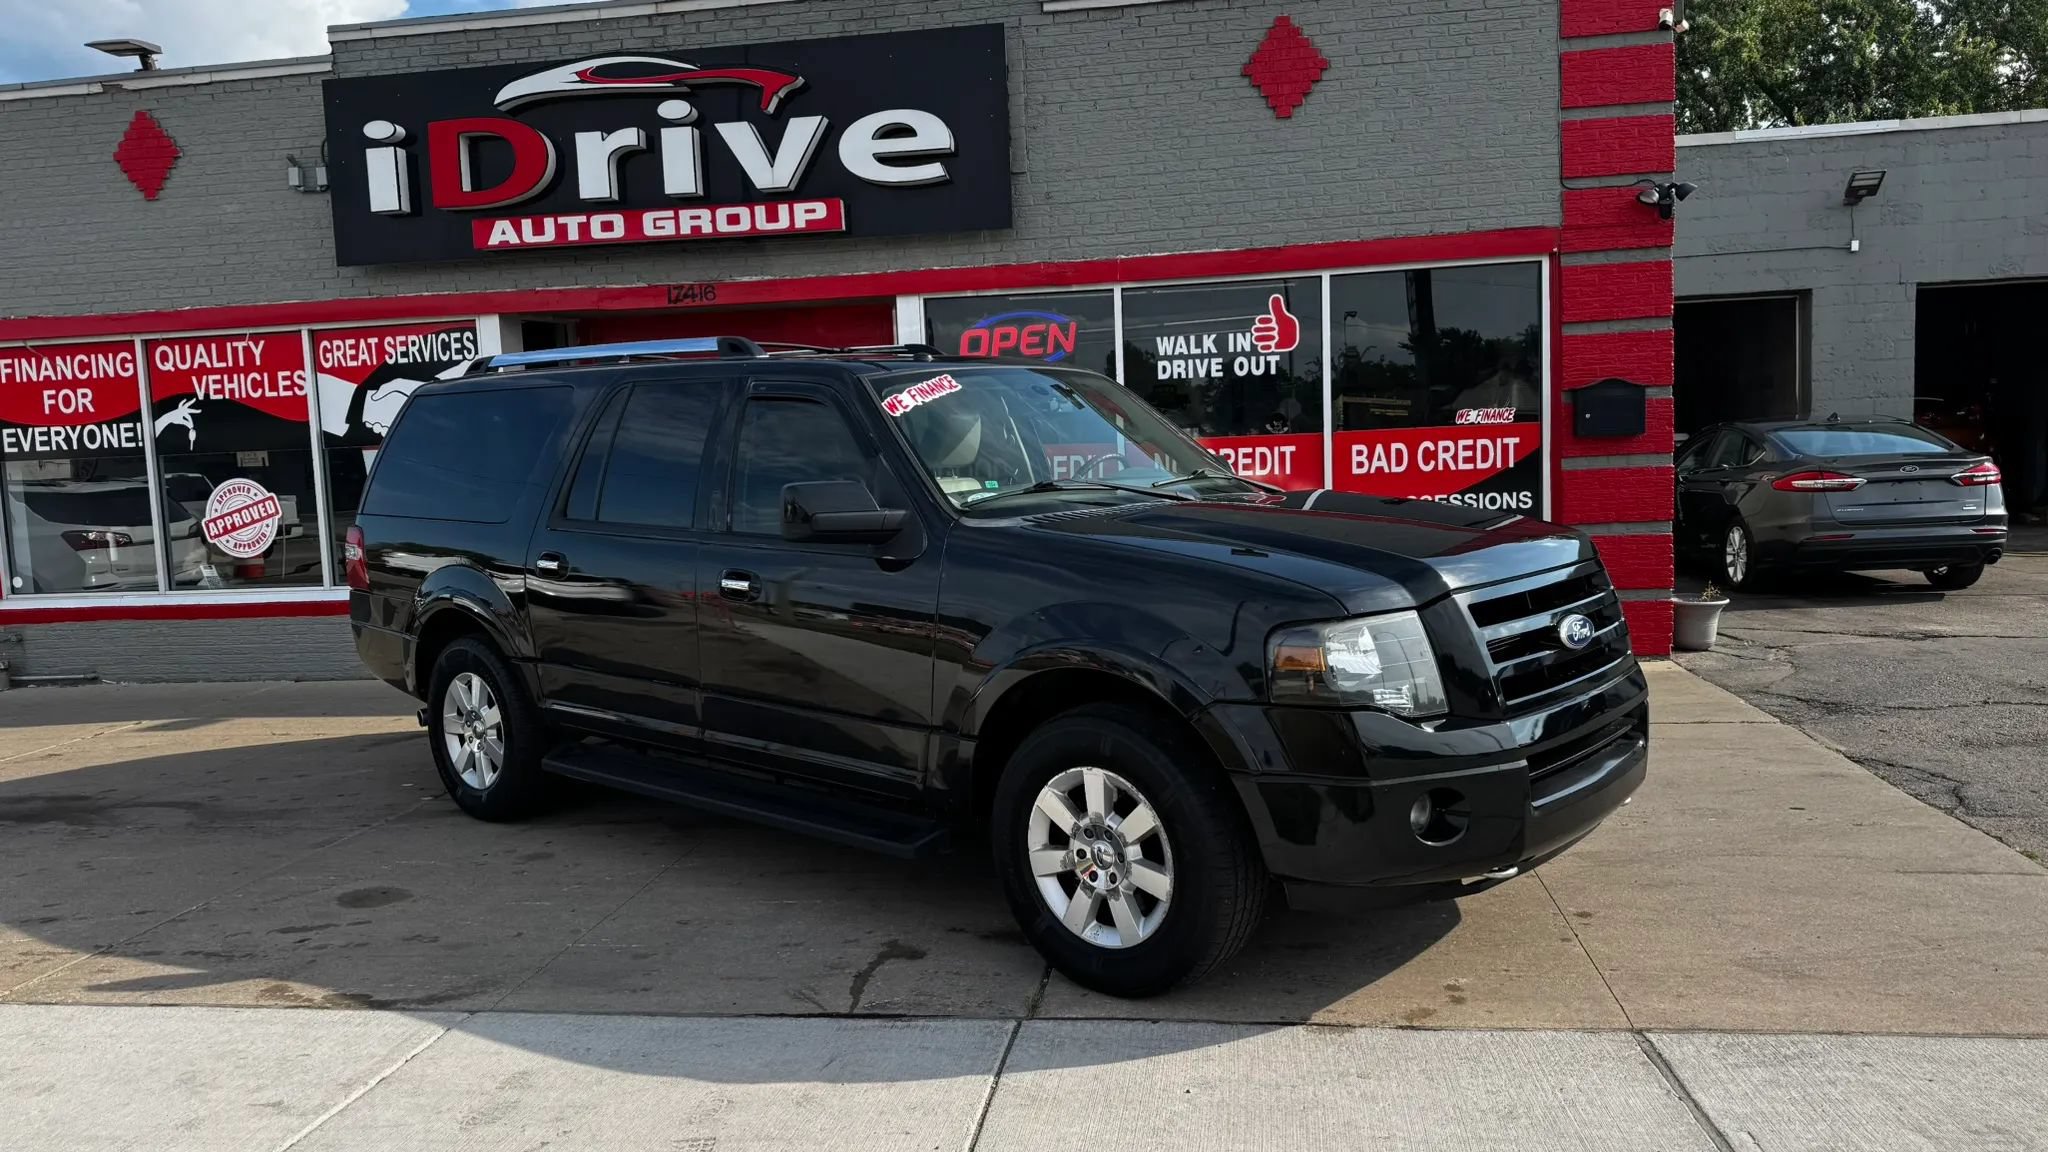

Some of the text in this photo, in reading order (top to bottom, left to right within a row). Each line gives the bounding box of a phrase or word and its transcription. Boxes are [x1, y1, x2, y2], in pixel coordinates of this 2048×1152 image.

[363, 99, 955, 213] iDrive
[487, 201, 827, 245] AUTO GROUP
[319, 330, 475, 369] GREAT SERVICES
[959, 321, 1078, 357] OPEN
[1156, 332, 1251, 356] WALK IN
[0, 352, 135, 384] FINANCING
[155, 340, 265, 372] QUALITY
[1157, 354, 1281, 380] DRIVE OUT
[192, 370, 307, 400] VEHICLES
[883, 375, 959, 415] WE FINANCE
[43, 388, 95, 415] FOR
[1456, 408, 1515, 423] WE FINANCE
[2, 422, 144, 453] EVERYONE!
[1206, 445, 1296, 476] REDIT
[1351, 436, 1520, 475] BAD CREDIT
[216, 485, 251, 505] APPROVED
[208, 499, 277, 537] APPROVED
[233, 532, 267, 551] APPROVED
